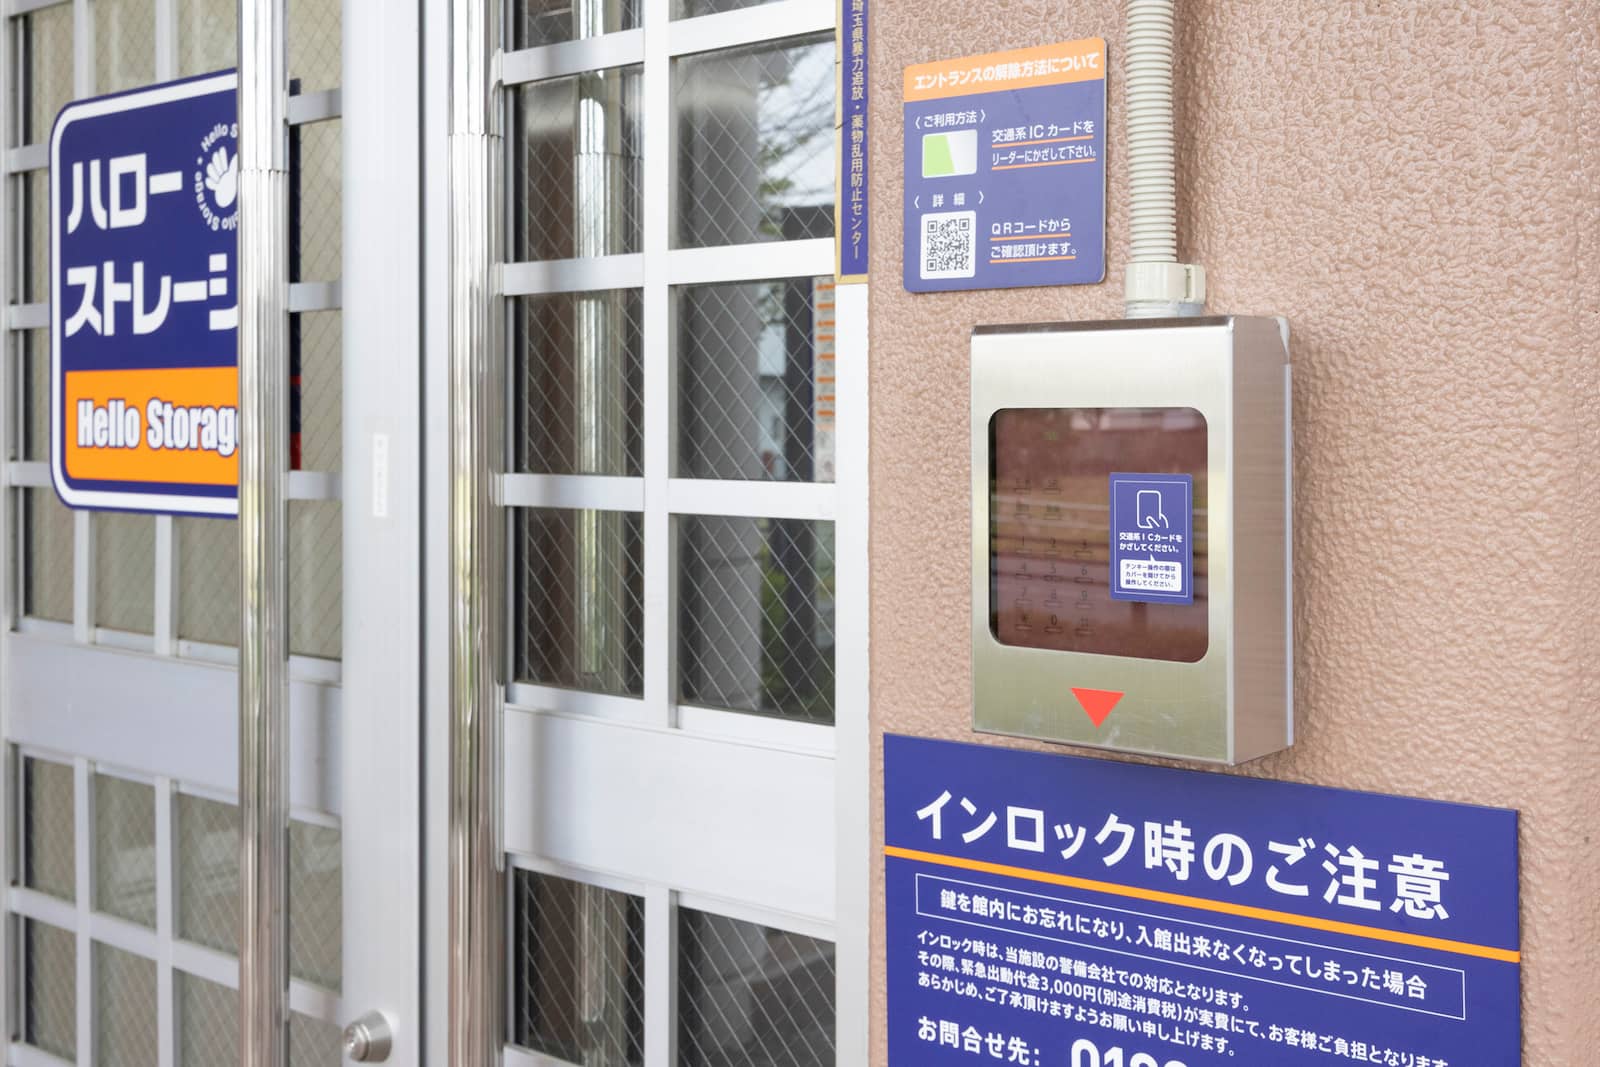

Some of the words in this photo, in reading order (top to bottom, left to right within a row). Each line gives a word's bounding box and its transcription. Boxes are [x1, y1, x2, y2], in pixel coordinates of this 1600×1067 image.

[914, 52, 1099, 90] エントランスの解除方法について
[201, 122, 229, 152] Hello
[992, 145, 1096, 166] リーダーにかざして下さい。
[67, 152, 183, 235] ハロー
[990, 241, 1077, 259] ご確認頂けます。
[991, 218, 1071, 235] QRコードから
[77, 397, 142, 449] Hello
[147, 396, 239, 457] Storag
[1120, 542, 1179, 553] かざしてください。
[916, 790, 1449, 919] インロック時のご注意
[940, 889, 1427, 999] 鍵を館内にお忘れになり、入館出来なくなってしまった場合
[917, 930, 1248, 1011] インロック時は、当施設の警備会社での対応となります。
[918, 971, 1234, 1056] あらかじめ、ご了承頂けますようお願い申し上げます。
